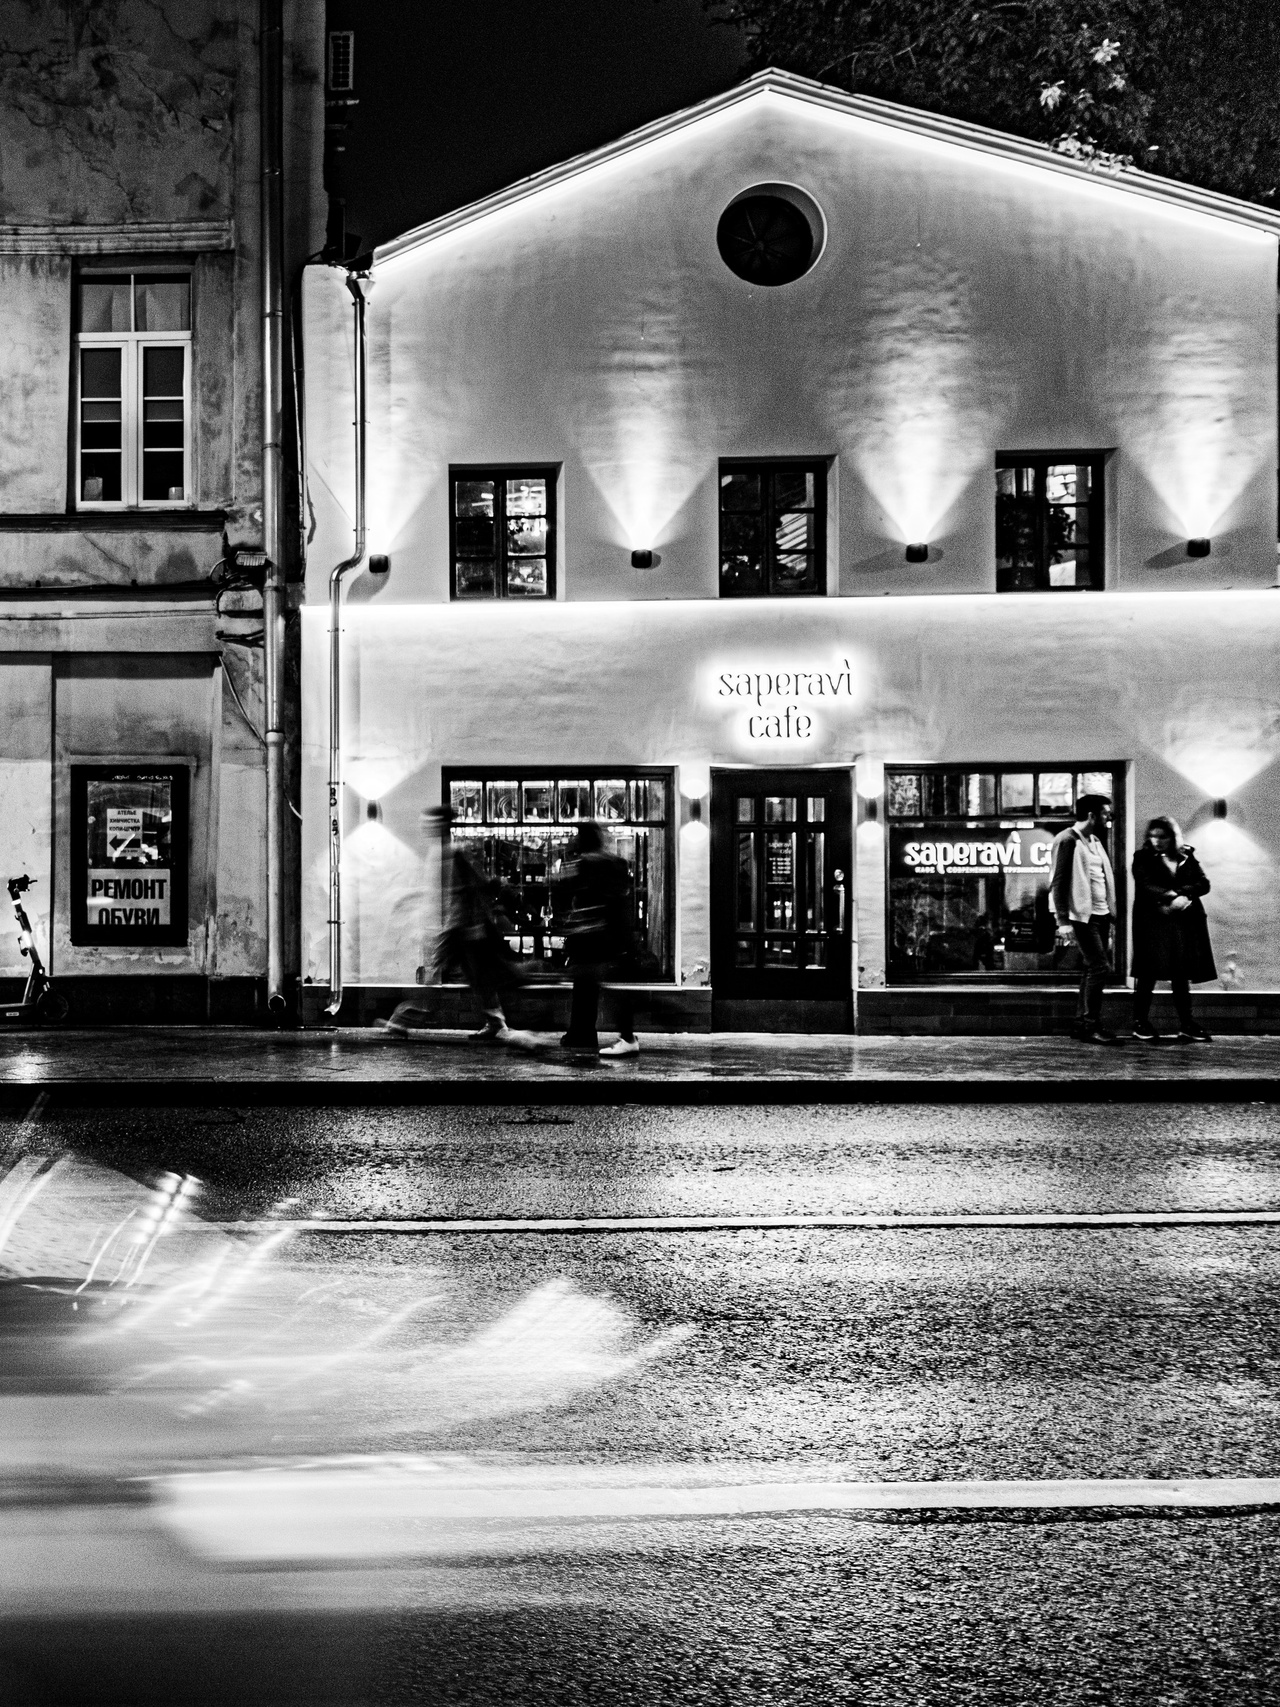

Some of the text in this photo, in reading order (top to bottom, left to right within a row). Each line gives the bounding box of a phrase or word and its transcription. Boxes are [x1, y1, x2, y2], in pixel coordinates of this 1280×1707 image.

[749, 705, 812, 738] cafe
[946, 865, 1000, 874] СОВРЕМЕННОЙ
[91, 879, 168, 900] РЕМОНТ
[98, 907, 160, 925] ОБУВИ
